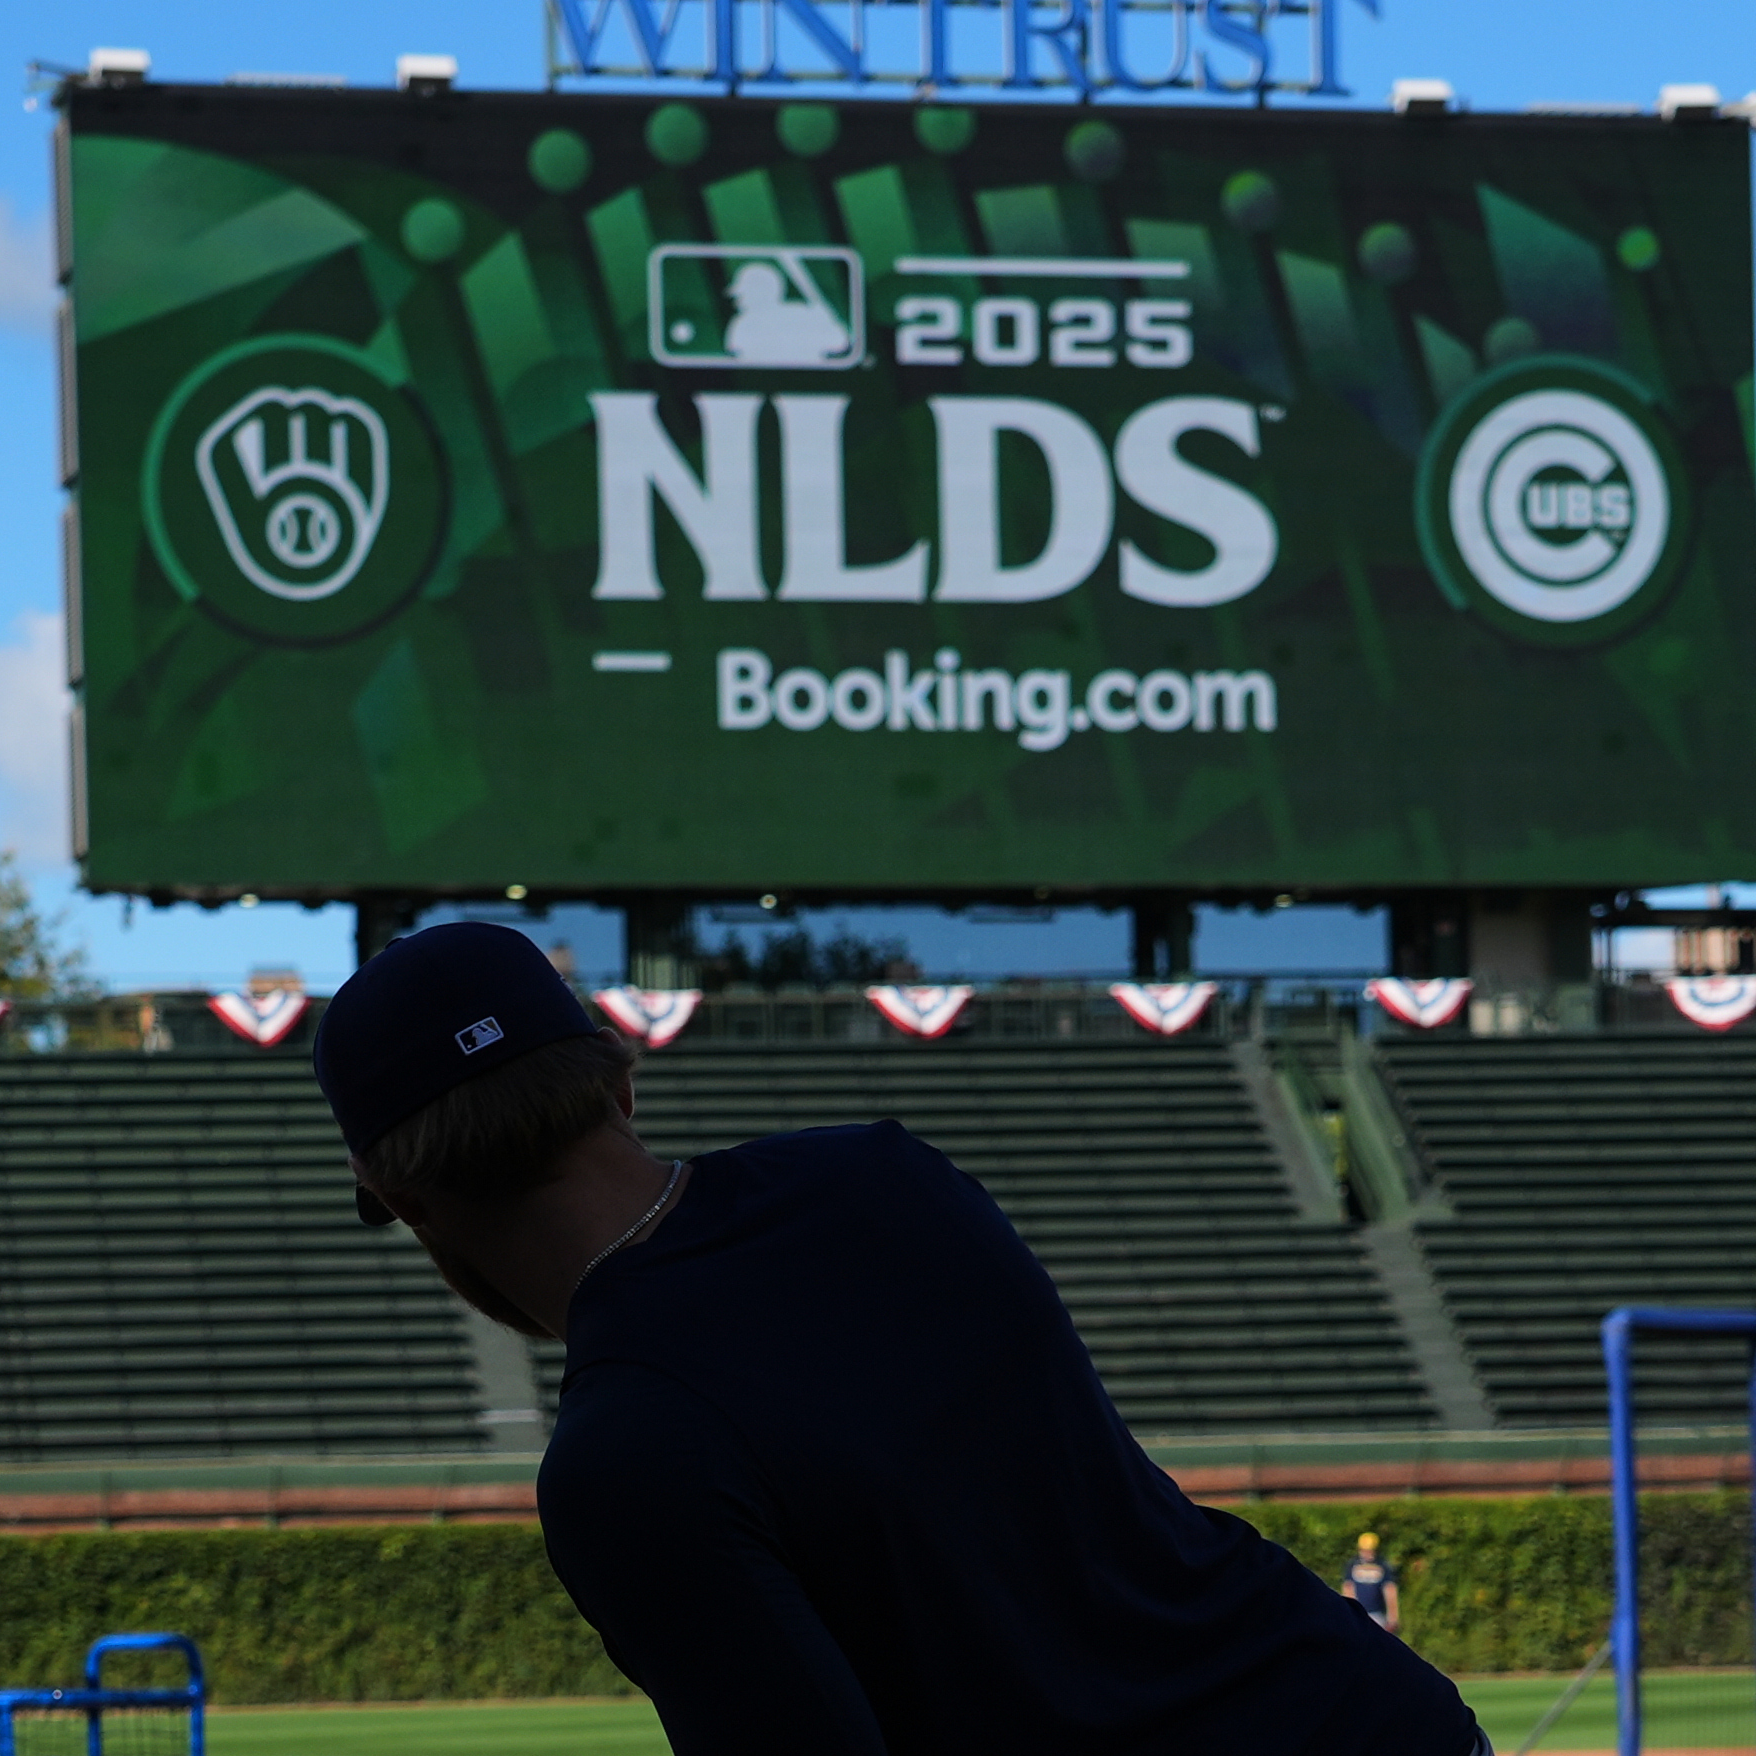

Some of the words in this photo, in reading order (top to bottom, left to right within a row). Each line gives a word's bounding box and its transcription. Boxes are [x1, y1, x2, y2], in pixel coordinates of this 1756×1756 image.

[551, 0, 1381, 95] WINTRUST
[894, 296, 1195, 369] 2025
[587, 390, 1280, 608] NLDS
[716, 648, 1277, 752] Booking.com
